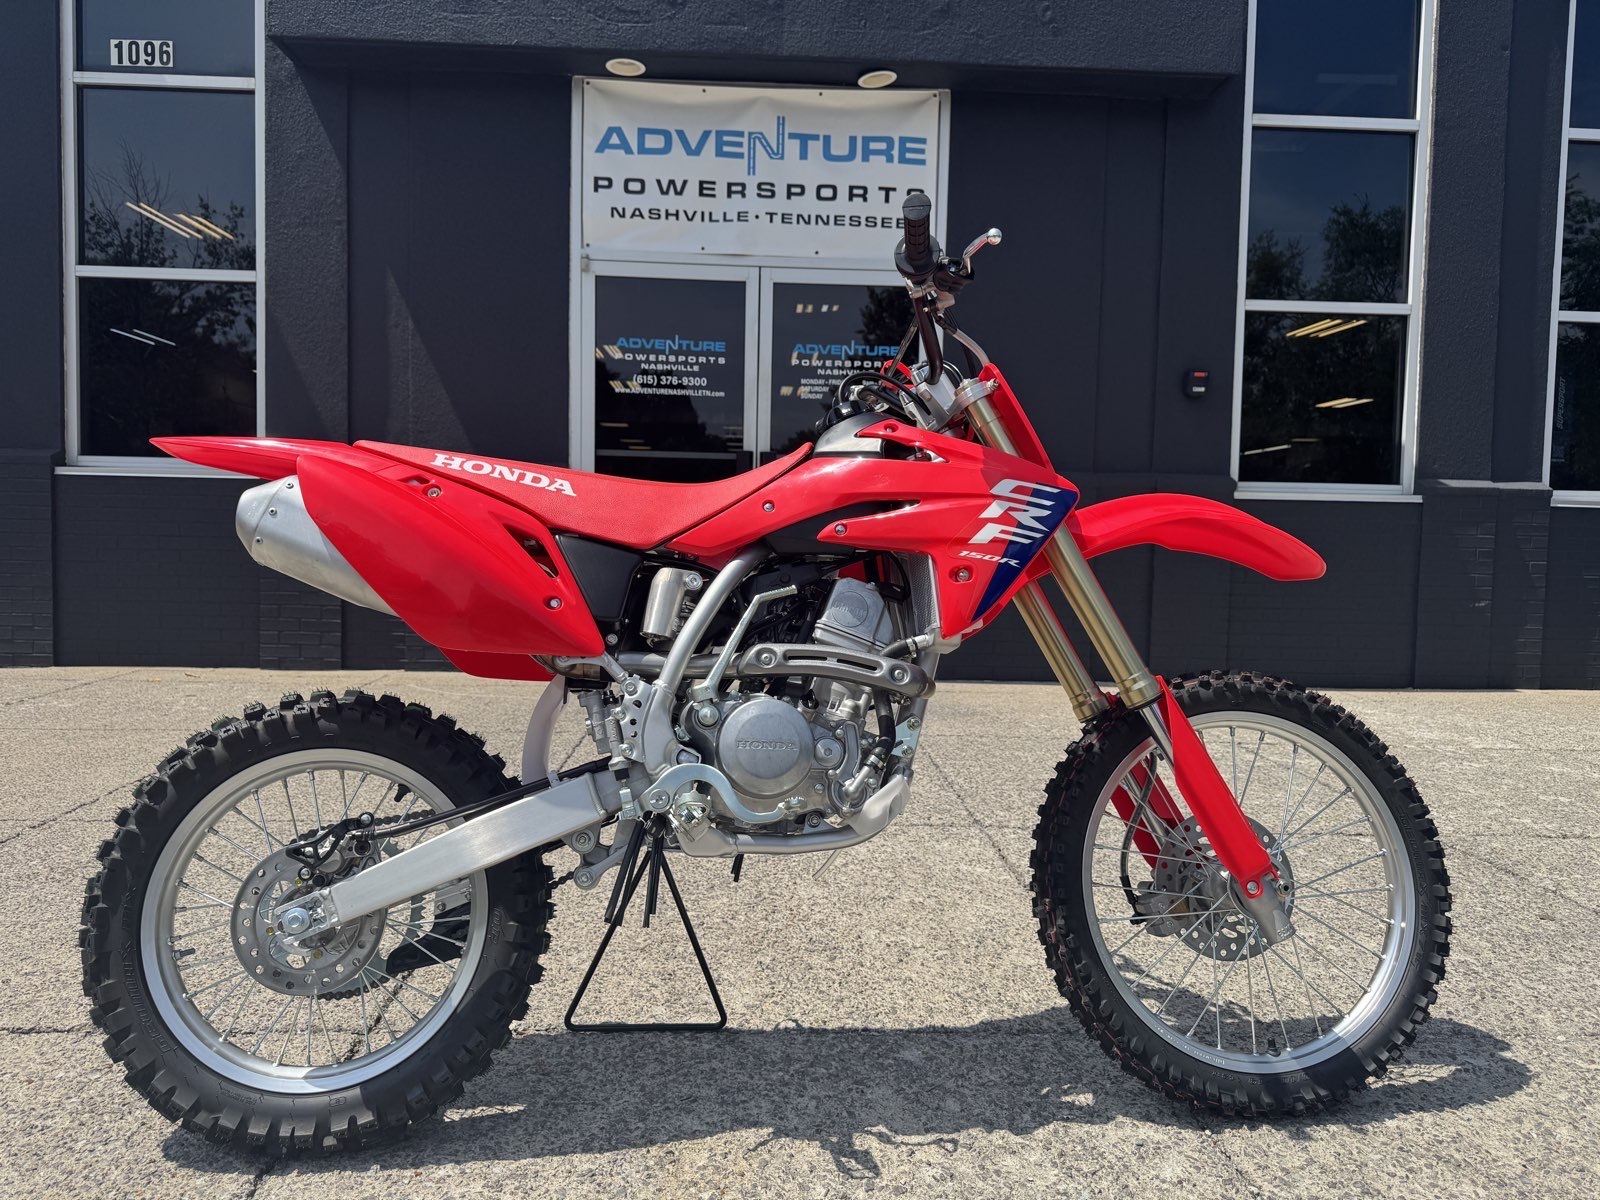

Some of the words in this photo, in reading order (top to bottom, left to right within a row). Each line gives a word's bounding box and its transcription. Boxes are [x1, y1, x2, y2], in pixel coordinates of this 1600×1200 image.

[114, 40, 171, 66] 1096
[594, 115, 927, 176] ADVENTURE
[610, 206, 749, 223] NASHVILLE
[616, 335, 726, 355] ADVENTURE
[793, 340, 900, 360] ADVENTURE
[614, 353, 726, 364] POWERSPORTS
[641, 363, 700, 372] NASHVILLE
[792, 359, 882, 368] POWERSPOR
[633, 374, 658, 386] (615)
[660, 376, 707, 386] 376-9300
[1556, 377, 1566, 429] SUPERSPORT
[430, 453, 577, 497] HONDA
[968, 478, 1062, 544] CRF
[958, 550, 1021, 568] 150R
[736, 740, 799, 750] HONDA
